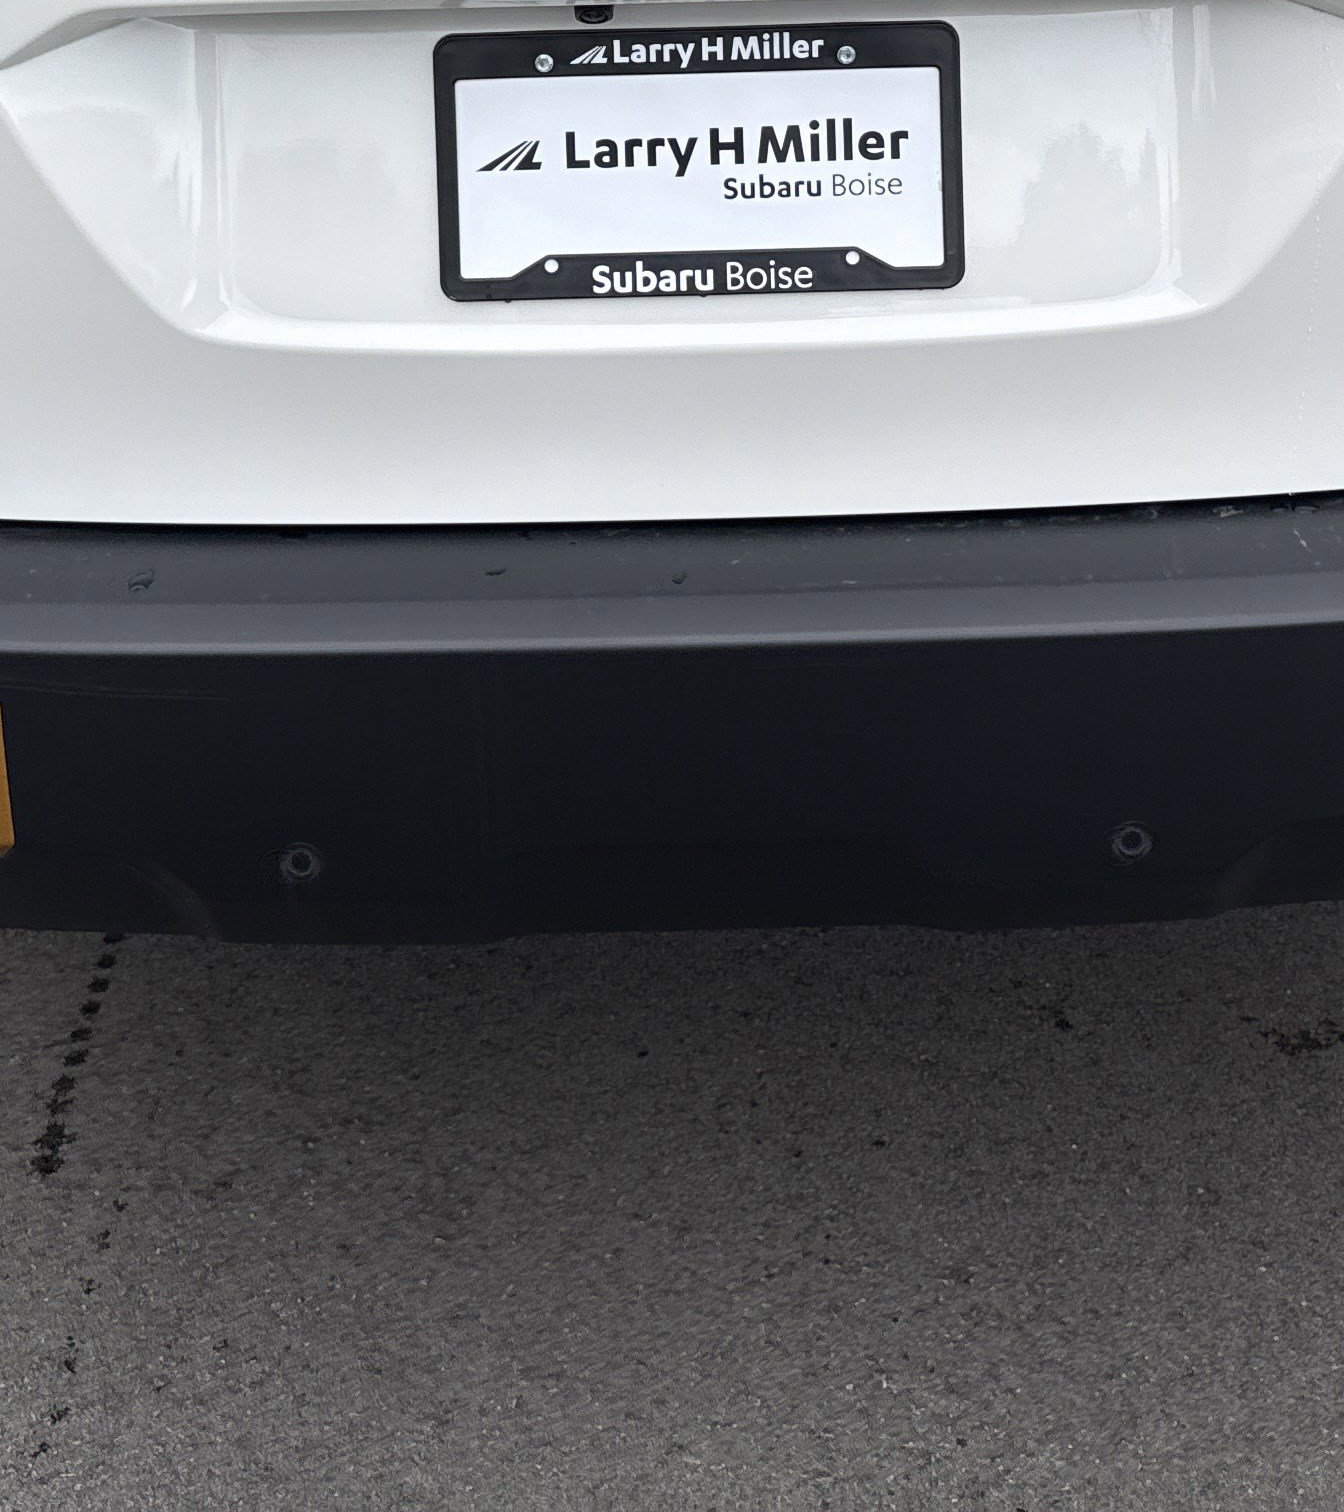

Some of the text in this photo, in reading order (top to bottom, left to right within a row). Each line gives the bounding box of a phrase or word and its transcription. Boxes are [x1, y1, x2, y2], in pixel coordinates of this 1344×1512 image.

[612, 32, 825, 69] Larry H Miller
[565, 117, 910, 178] Larry H Miller
[723, 173, 903, 200] Subaru Boise
[591, 260, 814, 295] Subaru Boise
